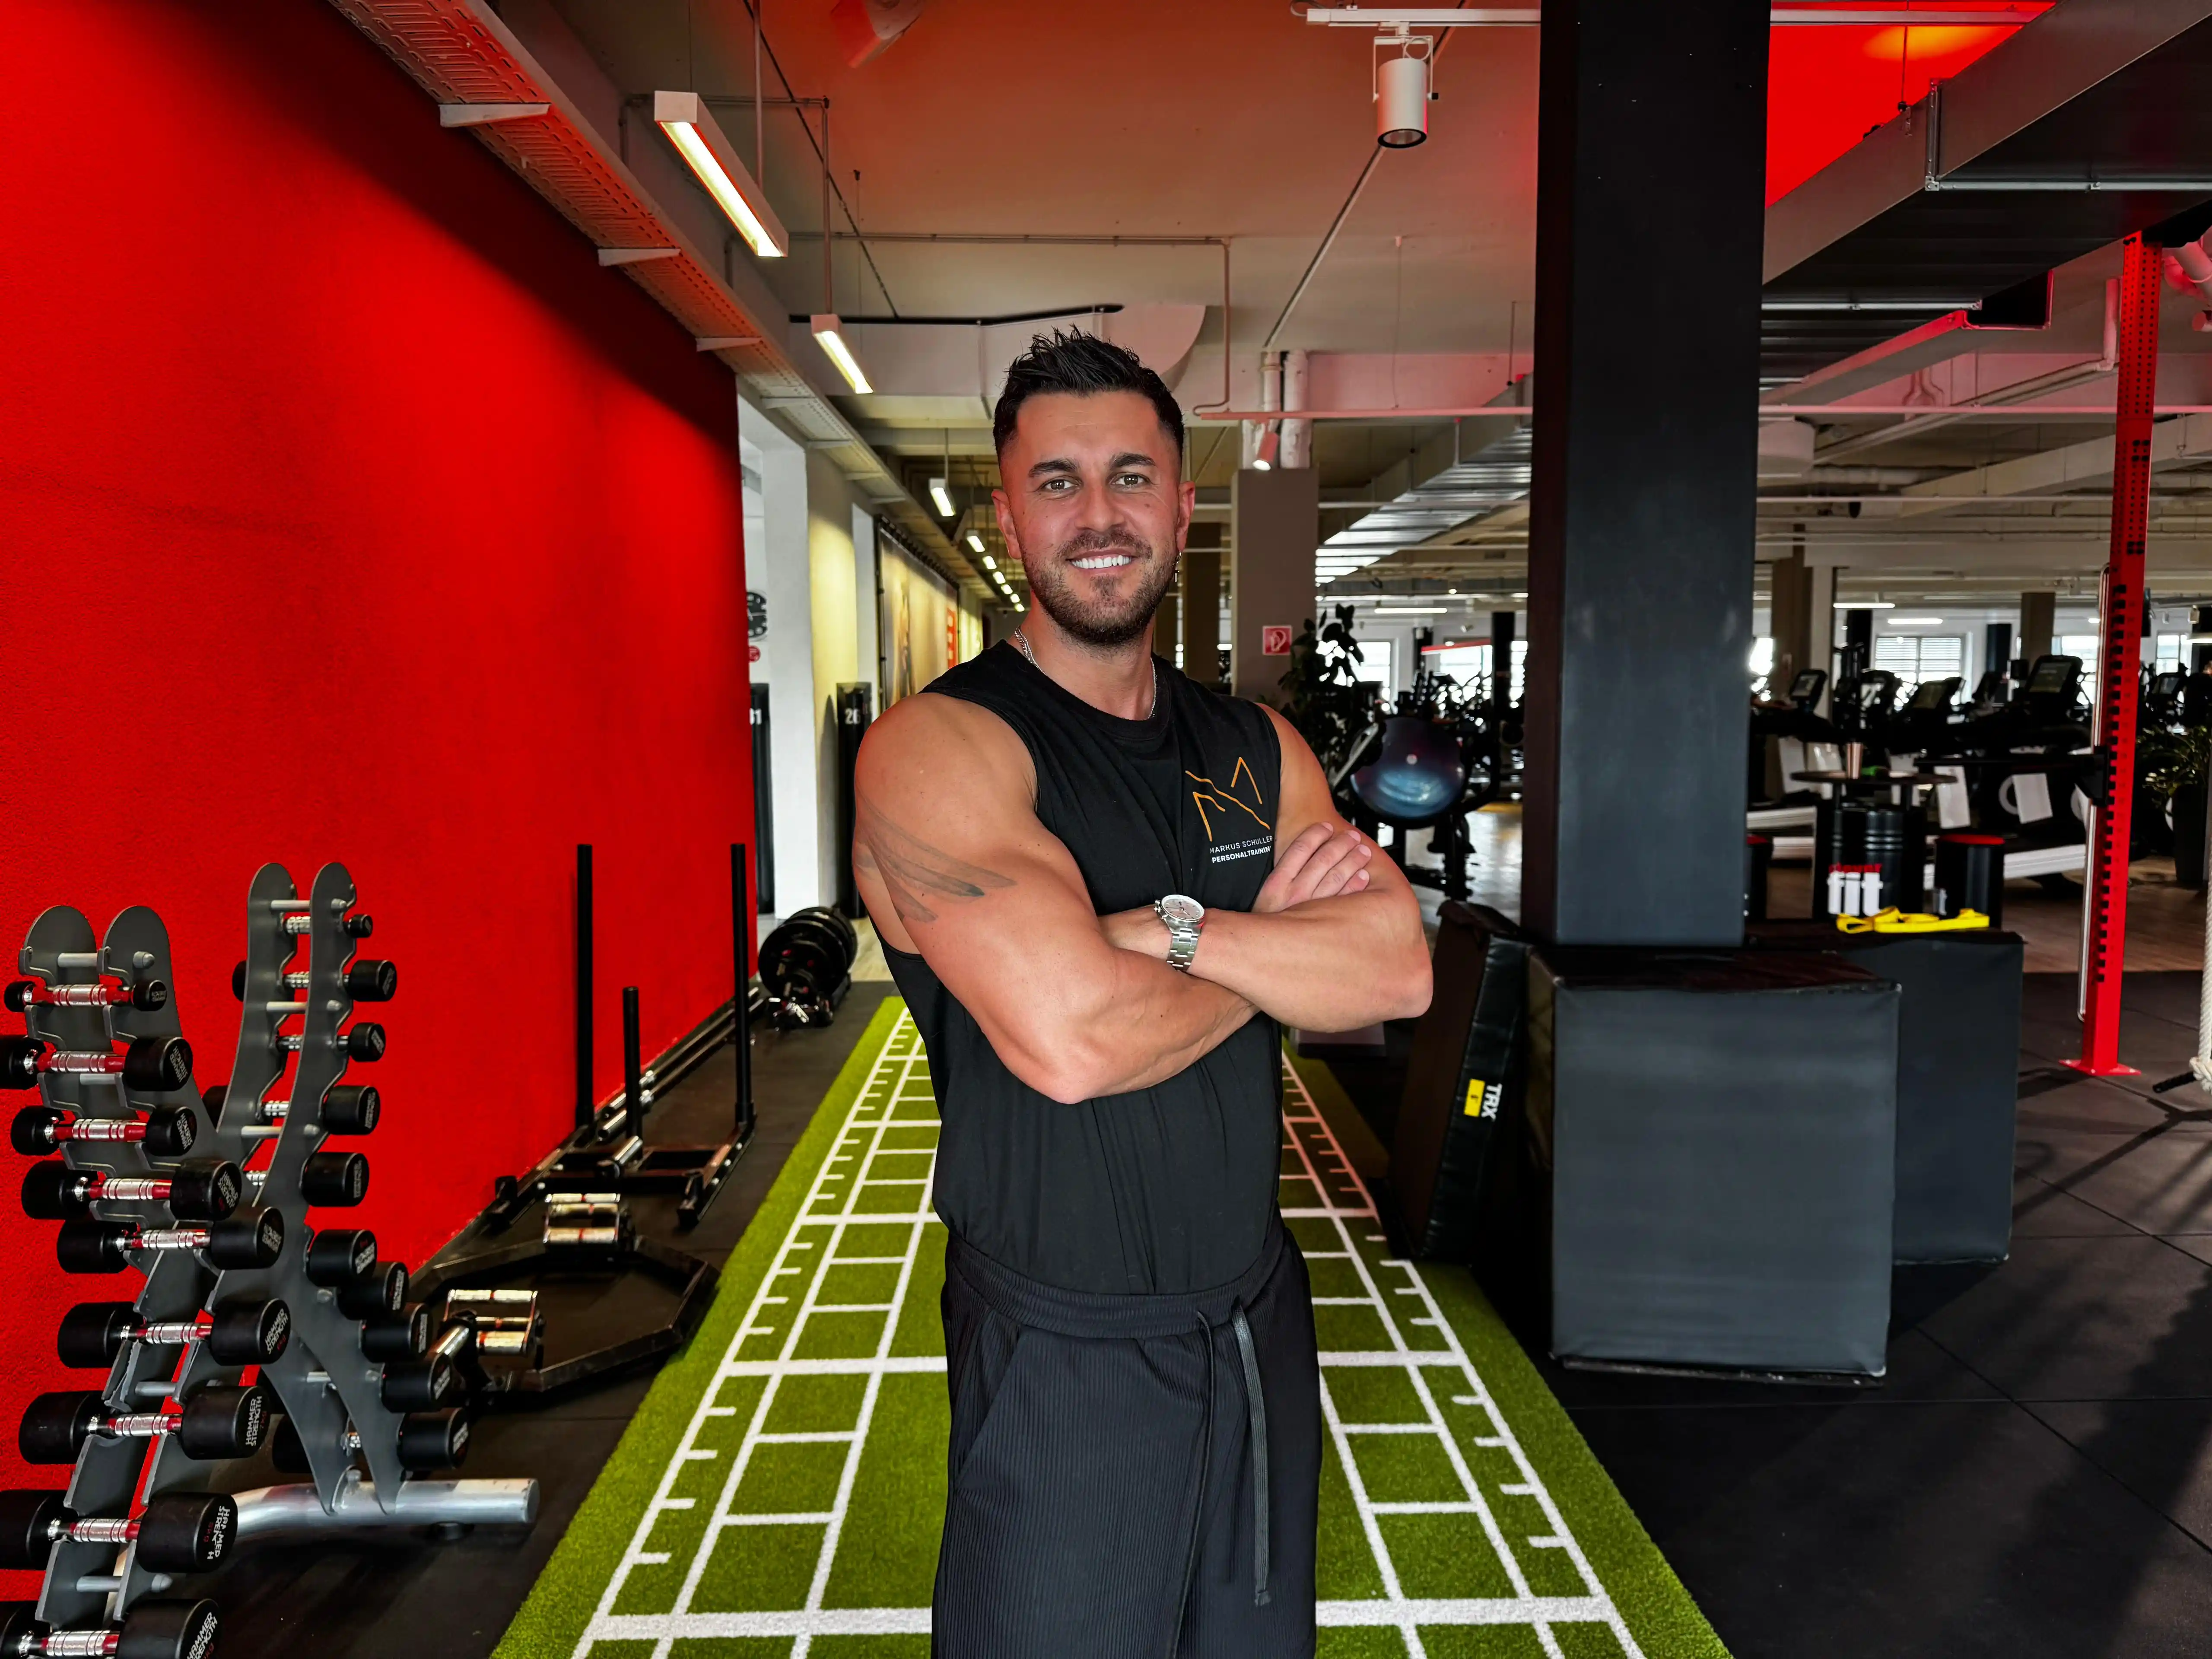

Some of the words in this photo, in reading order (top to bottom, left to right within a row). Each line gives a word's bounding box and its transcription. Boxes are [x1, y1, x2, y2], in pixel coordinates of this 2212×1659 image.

[1210, 842, 1240, 854] MARKUS
[1242, 835, 1273, 847] SCHULLER
[1211, 845, 1271, 863] PERSONALTRAININ
[1827, 871, 1884, 917] fit
[1481, 1083, 1503, 1122] TRX
[176, 1120, 188, 1150] HAMMER
[264, 1308, 284, 1347] HAMMER
[267, 1313, 289, 1354] STRENGTH
[245, 1398, 256, 1445] HAMMER
[251, 1396, 262, 1446] STRENGTH
[187, 1612, 213, 1659] HAMMER
[194, 1616, 218, 1659] RENGTH
